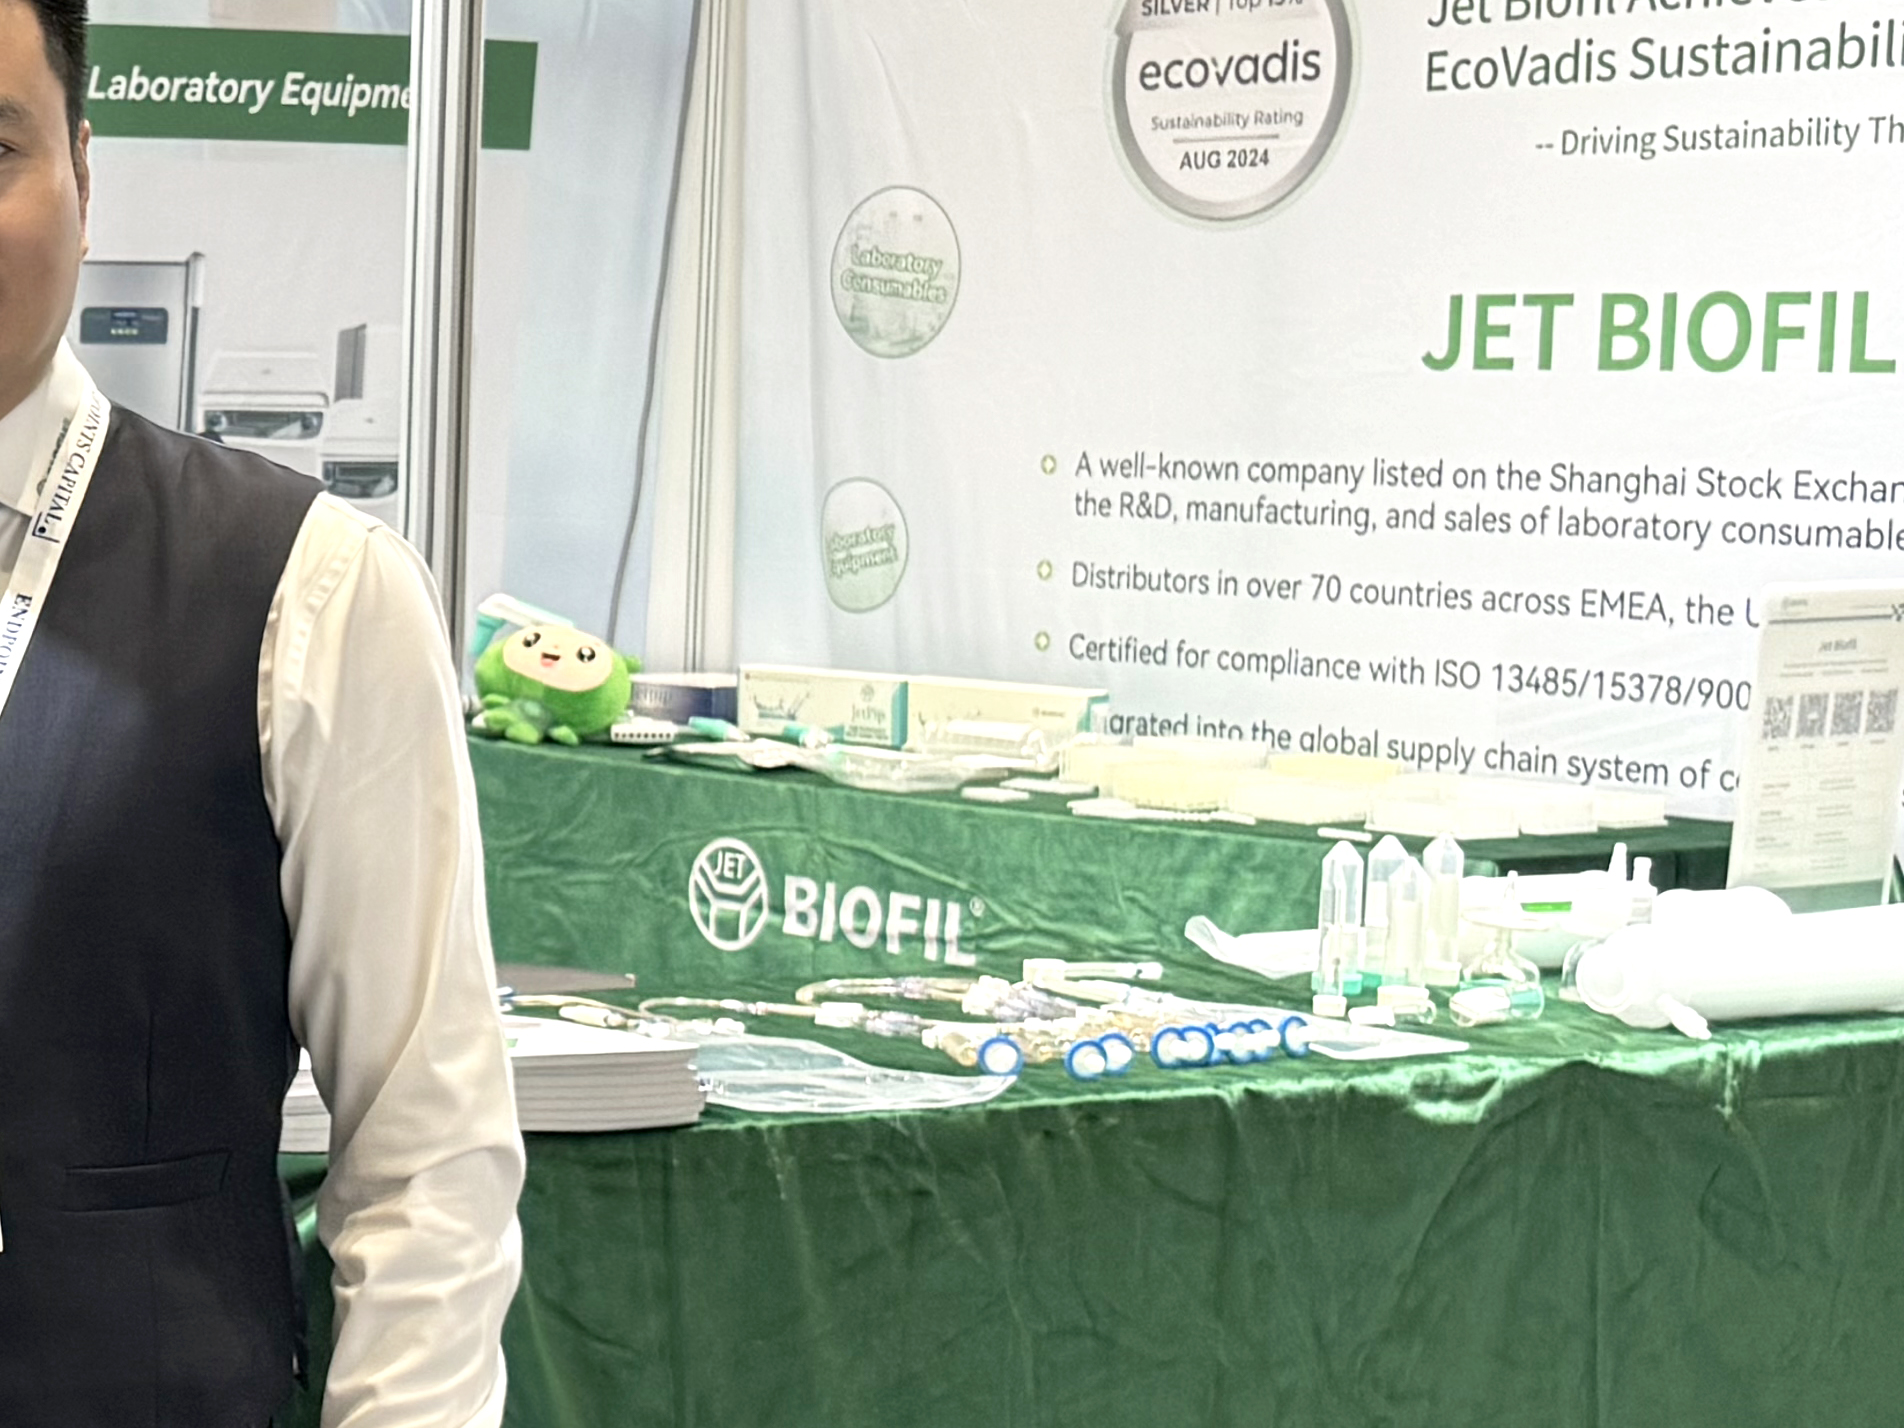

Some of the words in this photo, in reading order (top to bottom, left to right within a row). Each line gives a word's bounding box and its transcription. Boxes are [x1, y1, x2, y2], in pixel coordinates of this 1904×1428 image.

[1139, 39, 1321, 91] ecovadis
[1426, 38, 1617, 92] EcoVadis
[1629, 19, 1904, 80] Sustainabil
[87, 65, 274, 114] Laboratory
[1151, 112, 1250, 130] Sustainability
[1254, 108, 1303, 127] Rating
[1561, 125, 1656, 160] Driving
[1663, 116, 1860, 153] Sustainability
[1179, 151, 1221, 170] AUG
[1227, 149, 1270, 169] 2024
[1422, 293, 1574, 372] JET
[1597, 291, 1897, 374] BIOFIL
[45, 452, 86, 525] CAPITAL
[1075, 451, 1092, 478] A
[1100, 452, 1240, 482] well-known
[1247, 459, 1364, 494] company
[1373, 457, 1443, 489] listed
[1452, 466, 1487, 490] on
[1496, 461, 1541, 491] the
[1550, 462, 1687, 503] Shanghai
[1696, 466, 1783, 500] Stock
[1075, 489, 1111, 518] the
[1120, 491, 1178, 524] R&D,
[1186, 495, 1377, 537] manufacturing,
[1386, 502, 1435, 531] and
[1444, 503, 1512, 534] sales
[1520, 505, 1551, 536] of
[1558, 504, 1712, 551] laboratory
[1072, 560, 1210, 596] Distributors
[1217, 570, 1238, 598] in
[1246, 576, 1302, 602] over
[1311, 573, 1342, 604] 70
[1350, 579, 1473, 612] countries
[1481, 590, 1570, 616] across
[1581, 589, 1675, 629] EMEA,
[1685, 594, 1735, 627] the
[1069, 632, 1168, 666] Certified
[1176, 639, 1210, 670] for
[1217, 647, 1360, 682] compliance
[1370, 656, 1424, 686] with
[1435, 659, 1482, 691] ISO
[1252, 720, 1291, 751] the
[1299, 724, 1380, 759] global
[1387, 737, 1475, 774] supply
[1484, 740, 1558, 776] chain
[1567, 752, 1669, 786] system
[1680, 758, 1713, 789] of
[714, 850, 747, 881] JET
